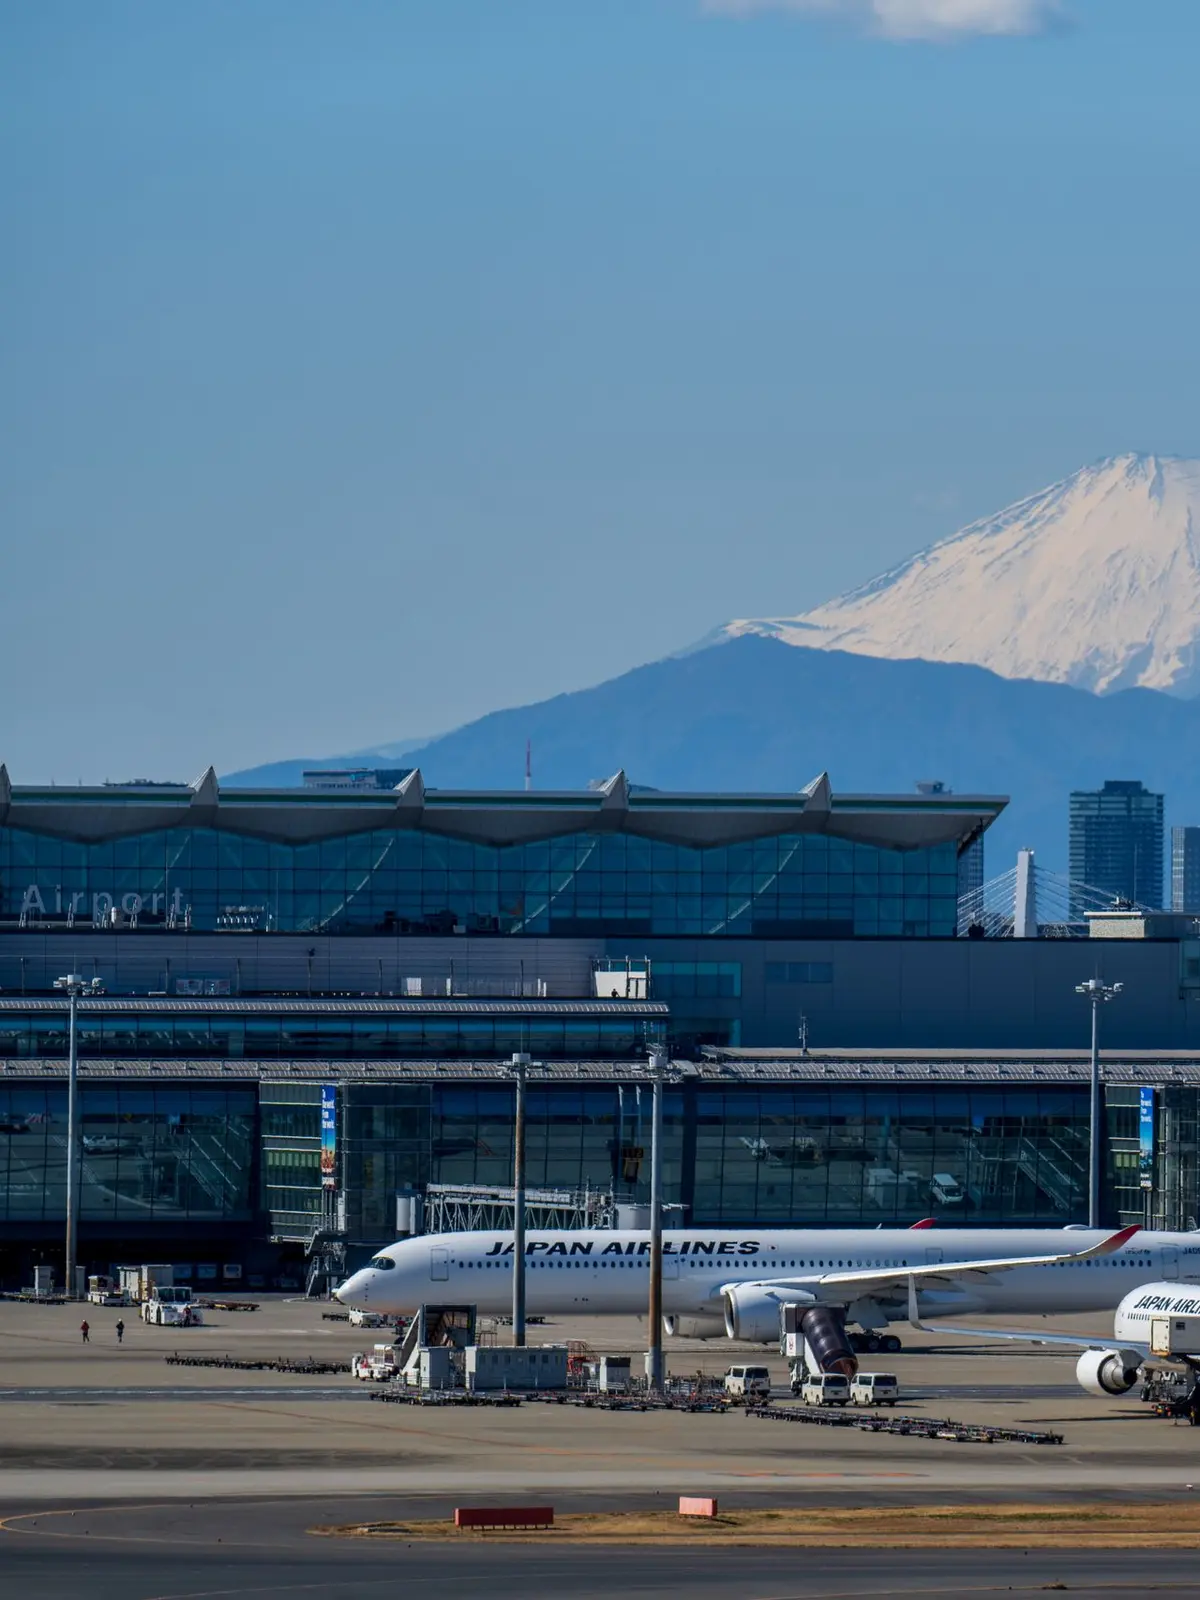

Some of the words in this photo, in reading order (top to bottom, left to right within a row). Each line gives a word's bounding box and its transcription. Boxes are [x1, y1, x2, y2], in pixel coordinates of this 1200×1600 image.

[21, 884, 184, 925] Airport
[601, 1241, 761, 1256] AIRLINES
[1133, 1295, 1176, 1312] JAPAN
